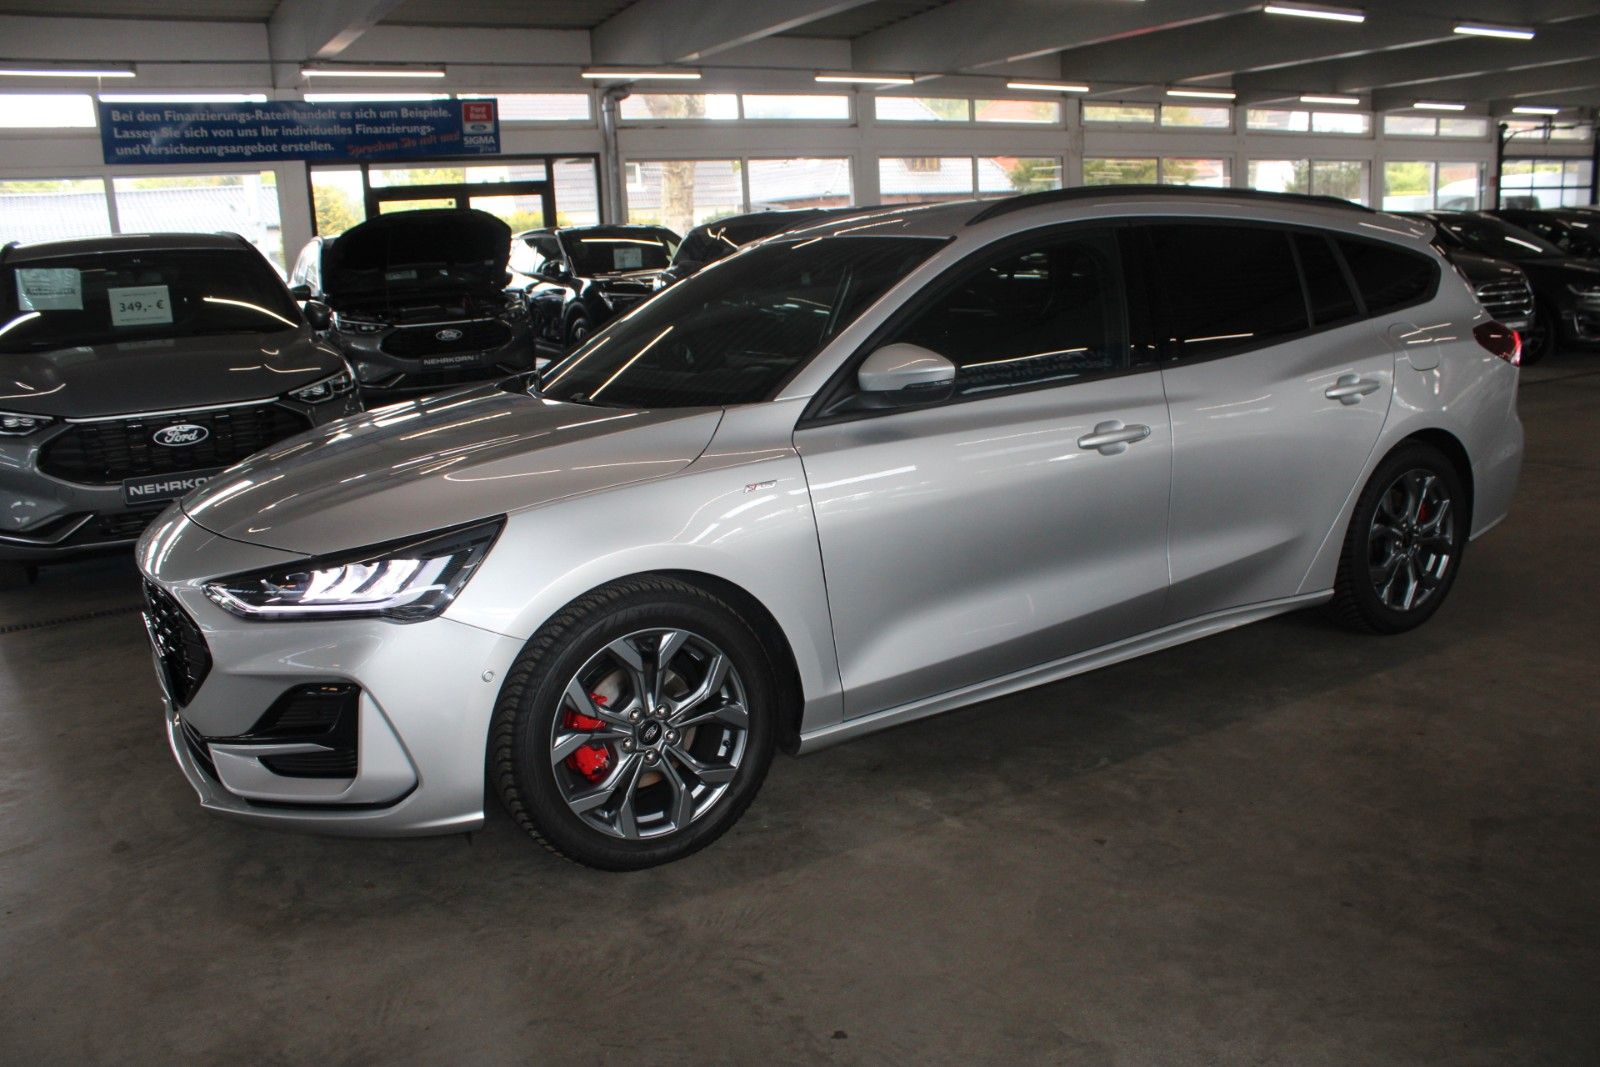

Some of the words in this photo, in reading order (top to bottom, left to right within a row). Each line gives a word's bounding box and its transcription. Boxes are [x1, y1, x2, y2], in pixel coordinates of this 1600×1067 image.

[111, 109, 133, 122] Bei
[137, 110, 161, 121] den
[164, 109, 289, 124] Finanzierungs-Raten
[293, 107, 336, 120] handelt
[339, 109, 352, 119] es
[355, 107, 378, 119] sich
[380, 109, 398, 118] um
[400, 107, 452, 120] Beispiele.
[113, 128, 156, 139] Lassen
[160, 126, 180, 138] Sie
[184, 127, 209, 138] sich
[211, 128, 234, 138] von
[237, 127, 258, 137] uns
[261, 126, 279, 136] Ihr
[282, 124, 352, 136] individuelles
[355, 123, 436, 137] Finanzierungs-
[463, 135, 496, 146] SIGMA
[116, 144, 140, 156] und
[142, 142, 278, 157] Versicherungsangebot
[281, 140, 335, 152] erstellen.
[156, 299, 165, 310] €
[423, 355, 474, 366] NEHRKORN
[164, 429, 198, 443] Ford
[129, 476, 213, 496] NEHRKO
